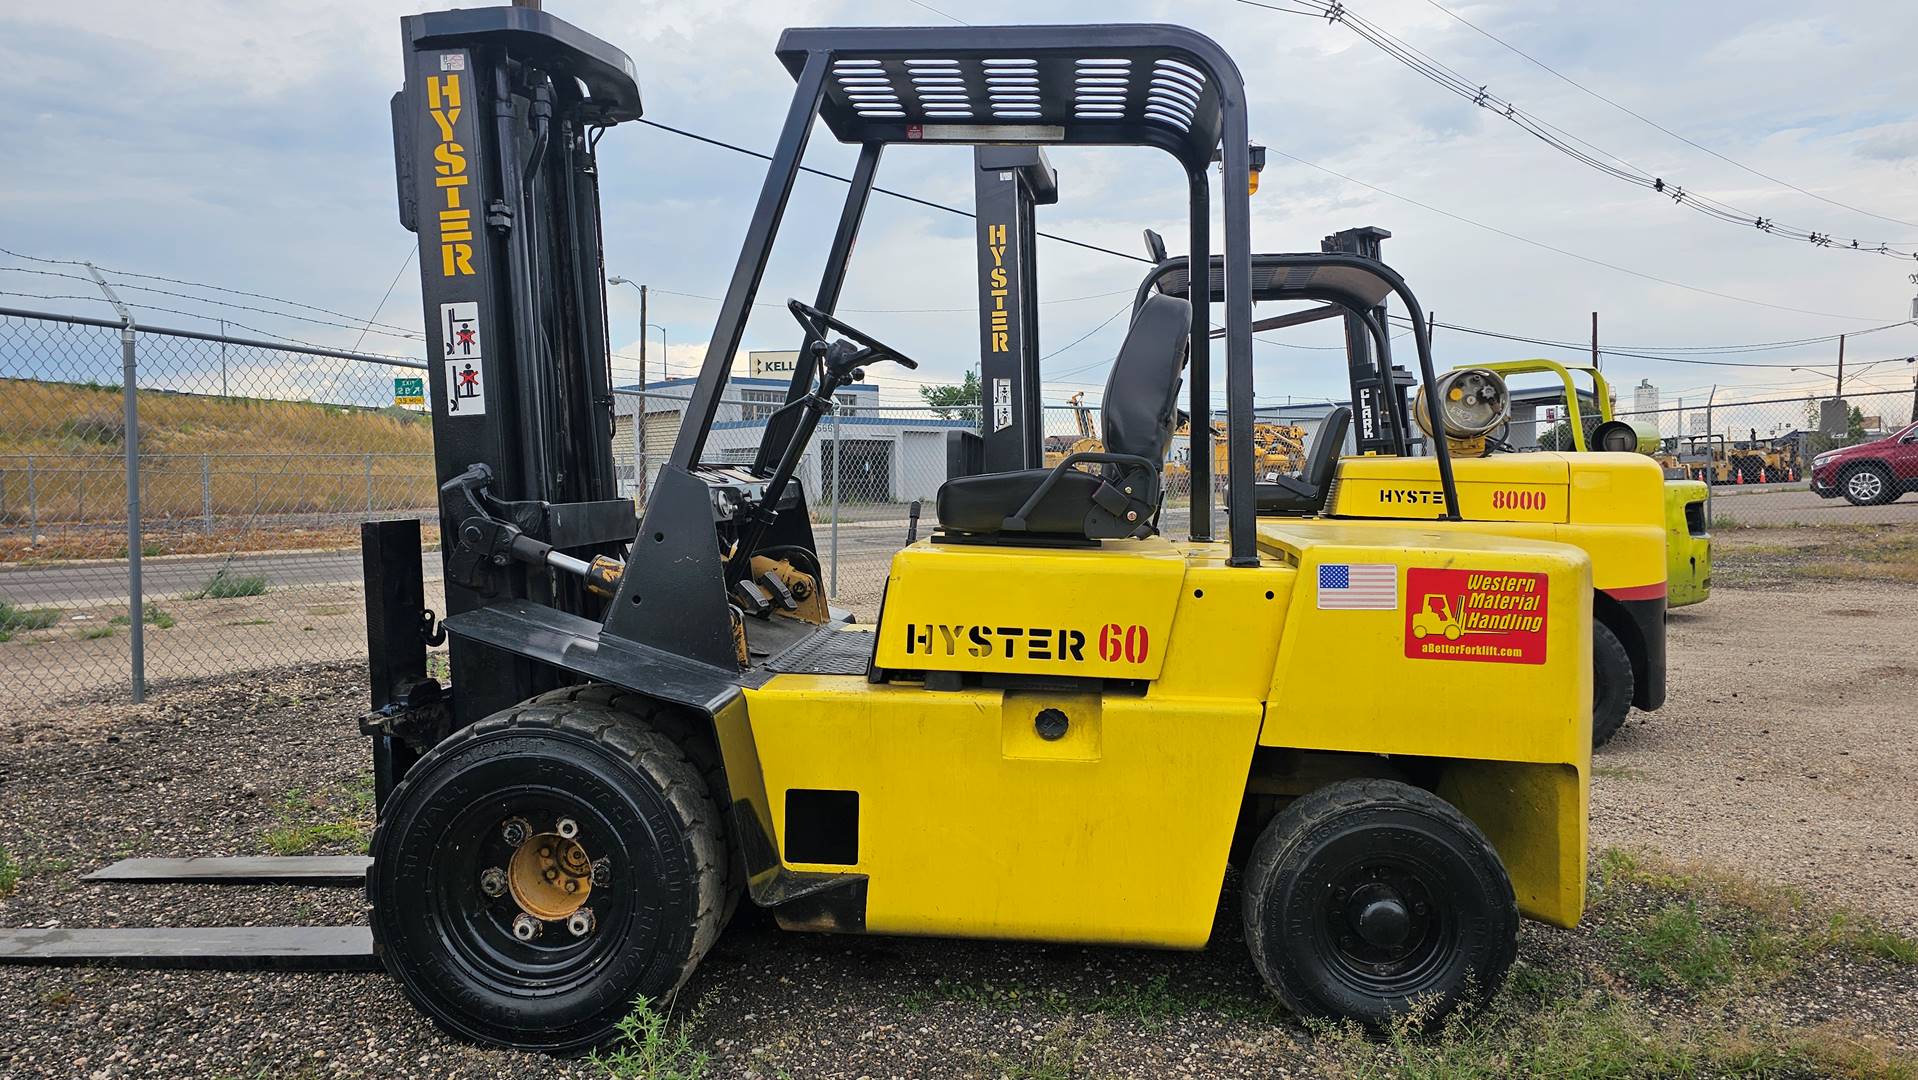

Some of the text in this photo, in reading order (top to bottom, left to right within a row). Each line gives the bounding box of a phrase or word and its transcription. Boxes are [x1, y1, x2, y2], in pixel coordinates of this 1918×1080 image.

[427, 74, 476, 277] HYSTER
[988, 224, 1009, 353] HYSTER
[1360, 388, 1374, 439] CLARK
[1380, 489, 1546, 511] HYSTE 8000
[1467, 574, 1536, 593] Western
[1468, 592, 1540, 611] Material
[1467, 612, 1543, 633] Handling
[907, 623, 1149, 664] HYSTER 60
[1422, 643, 1522, 657] aBetterForklift.com
